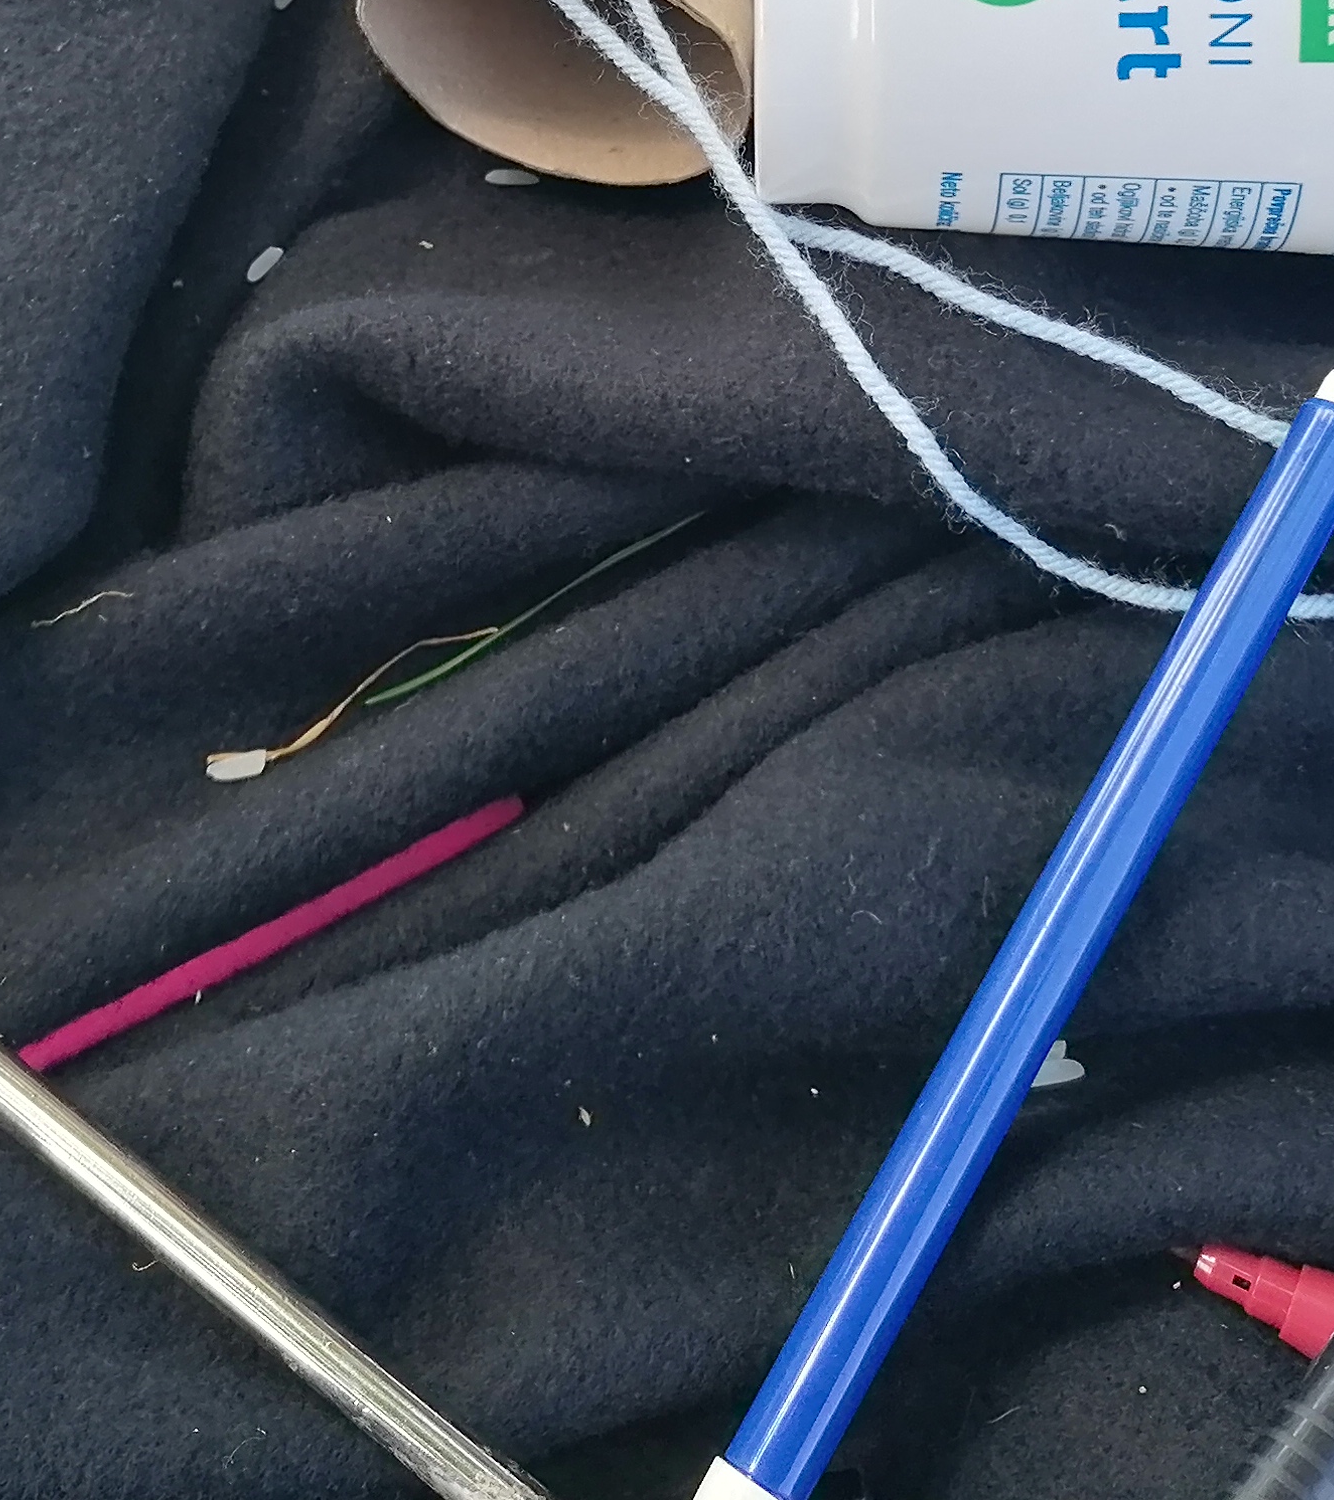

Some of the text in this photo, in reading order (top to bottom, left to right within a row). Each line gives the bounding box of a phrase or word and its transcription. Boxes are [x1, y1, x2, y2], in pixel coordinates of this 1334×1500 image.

[940, 171, 963, 199] Neto
[1012, 178, 1033, 195] Sol
[1005, 197, 1030, 210] (g)
[1091, 192, 1110, 205] od
[1116, 182, 1142, 222] Ogljikovi
[1159, 194, 1179, 209] od
[1183, 185, 1212, 228] Maščoba
[1088, 206, 1108, 220] teh
[1157, 209, 1177, 218] te
[1221, 186, 1253, 233] Energijska
